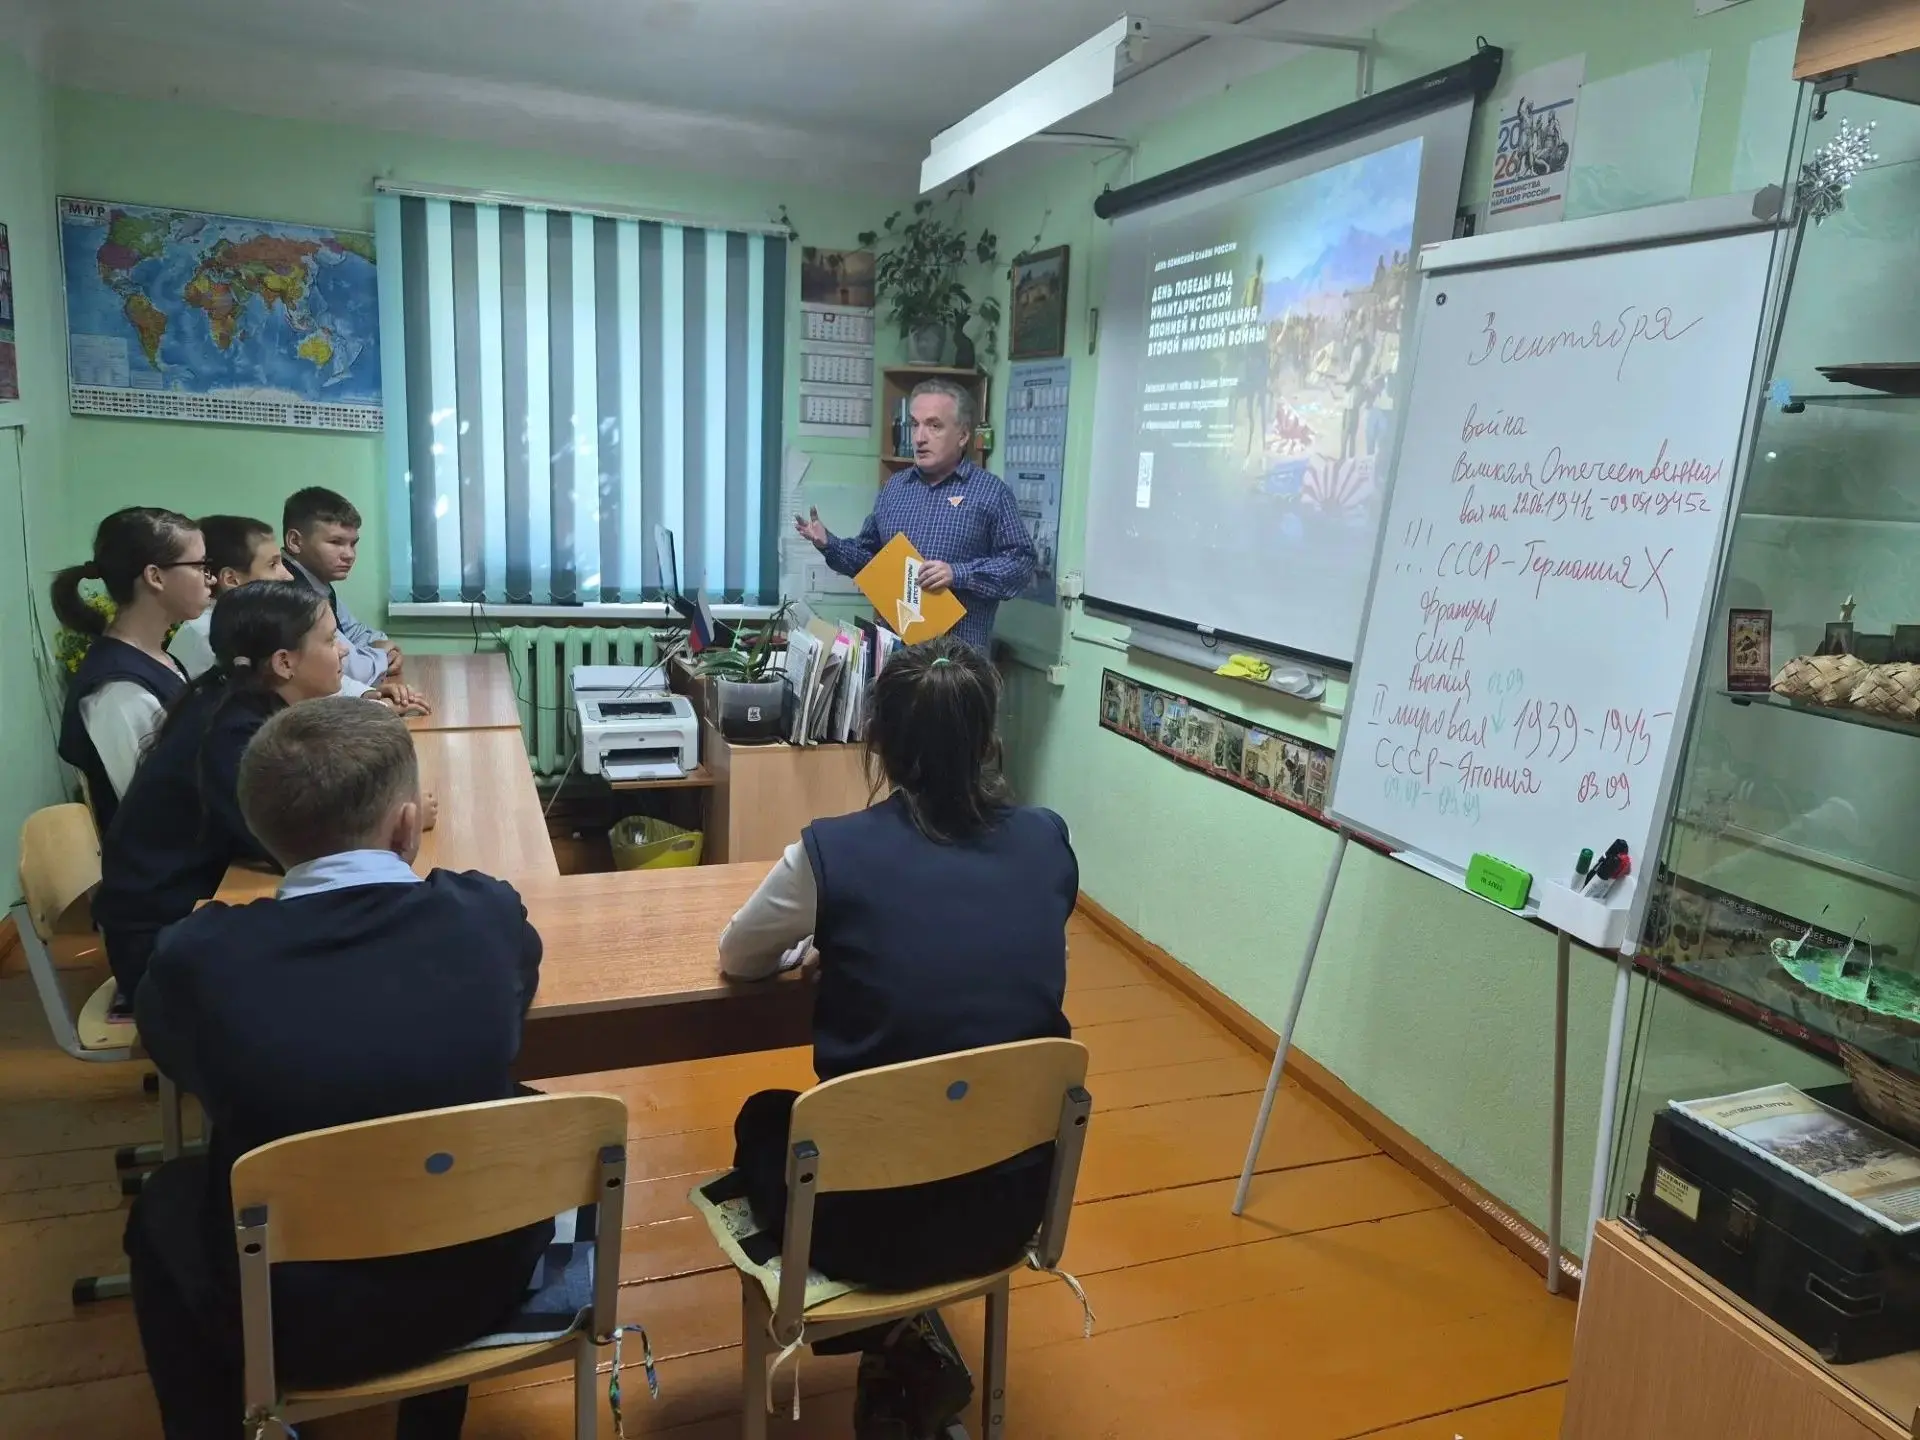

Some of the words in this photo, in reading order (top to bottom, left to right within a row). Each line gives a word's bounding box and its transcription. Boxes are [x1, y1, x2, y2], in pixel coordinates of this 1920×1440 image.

[68, 202, 106, 217] МИР
[1151, 284, 1173, 303] ДЕНЬ
[1174, 273, 1213, 297] ПОБЕДЫ
[1214, 269, 1234, 288] НАД
[1150, 287, 1232, 321] МИЛИТАРИСТСКОЙ
[1148, 315, 1188, 339] ЯПОНИЕЙ
[1189, 317, 1198, 332] И
[1199, 305, 1258, 330] ОКОНЧАНИЯ
[1147, 335, 1180, 357] ВТОРОЙ
[1181, 327, 1226, 353] МИРОВОЙ
[1228, 324, 1266, 347] ВОЙНЫ
[1500, 305, 1703, 381] сентября
[1719, 896, 1745, 913] НОВОЕ
[1746, 906, 1773, 925] ВРЕМЯ
